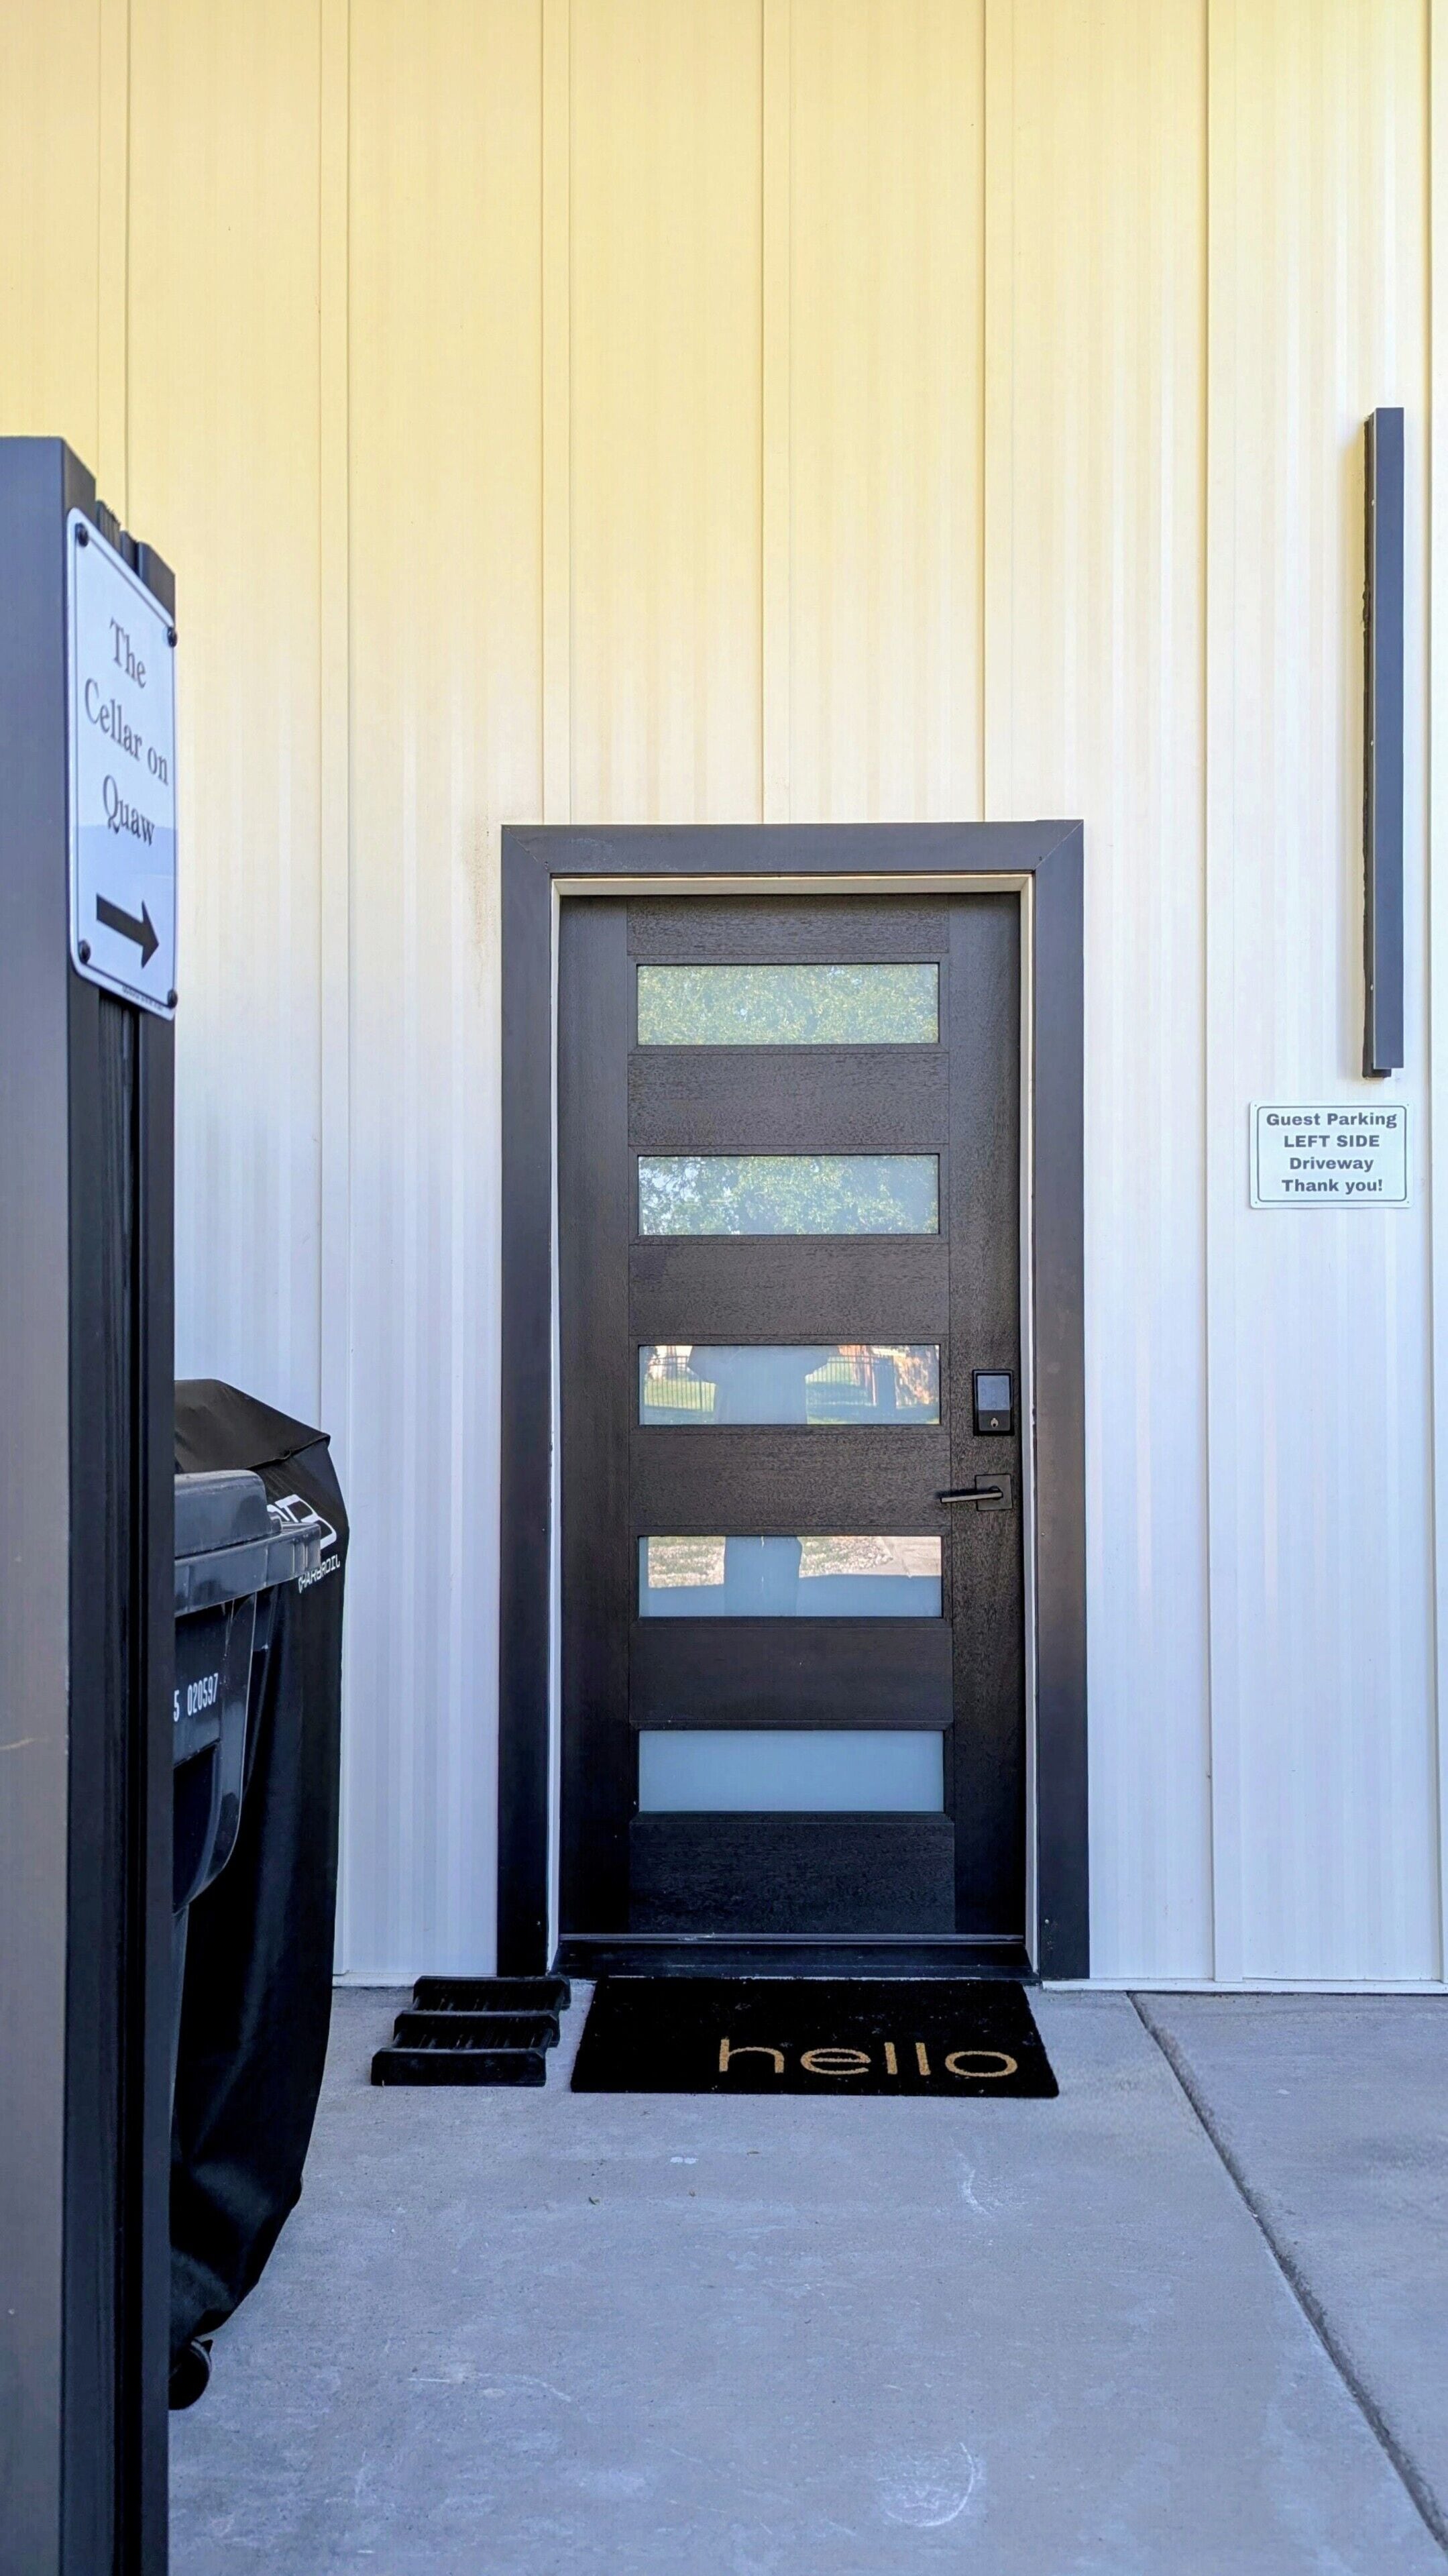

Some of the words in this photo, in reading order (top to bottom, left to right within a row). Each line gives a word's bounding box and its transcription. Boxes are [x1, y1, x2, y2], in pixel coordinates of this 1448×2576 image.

[109, 616, 146, 689] The
[85, 678, 143, 761] Cellar
[147, 746, 168, 786] on
[103, 774, 155, 846] Quaw
[1266, 1113, 1321, 1126] Guest
[1327, 1112, 1397, 1128] Parking
[1284, 1135, 1330, 1148] LEFT
[1337, 1135, 1380, 1147] SIDE
[1290, 1157, 1374, 1172] Driveway
[1282, 1179, 1339, 1192] Thank
[1345, 1179, 1382, 1195] you!
[187, 1672, 219, 1717] 020597
[719, 2037, 1018, 2078] hello
